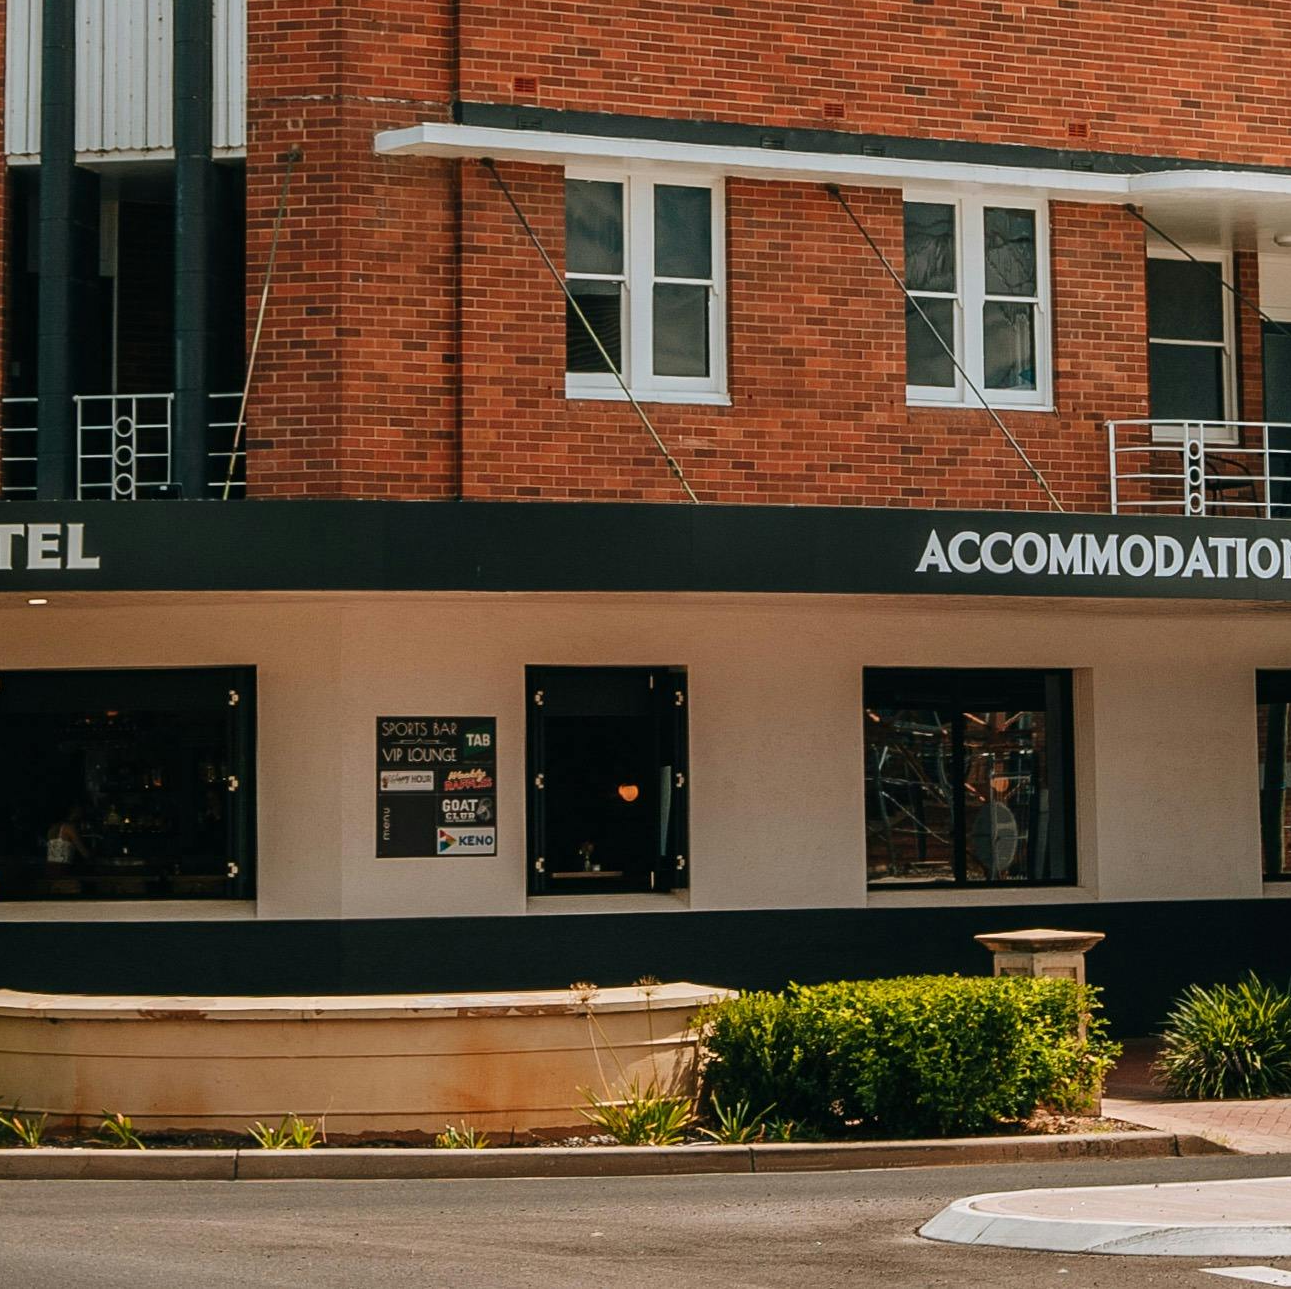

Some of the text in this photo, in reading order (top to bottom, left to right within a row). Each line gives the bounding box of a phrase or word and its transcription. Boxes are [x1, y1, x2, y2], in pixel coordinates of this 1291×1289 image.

[381, 722, 458, 736] SPORTS BAR
[465, 733, 491, 747] TAB
[382, 747, 458, 762] VIP LOUNGE
[442, 799, 478, 813] GOAT
[458, 835, 493, 846] KENO
